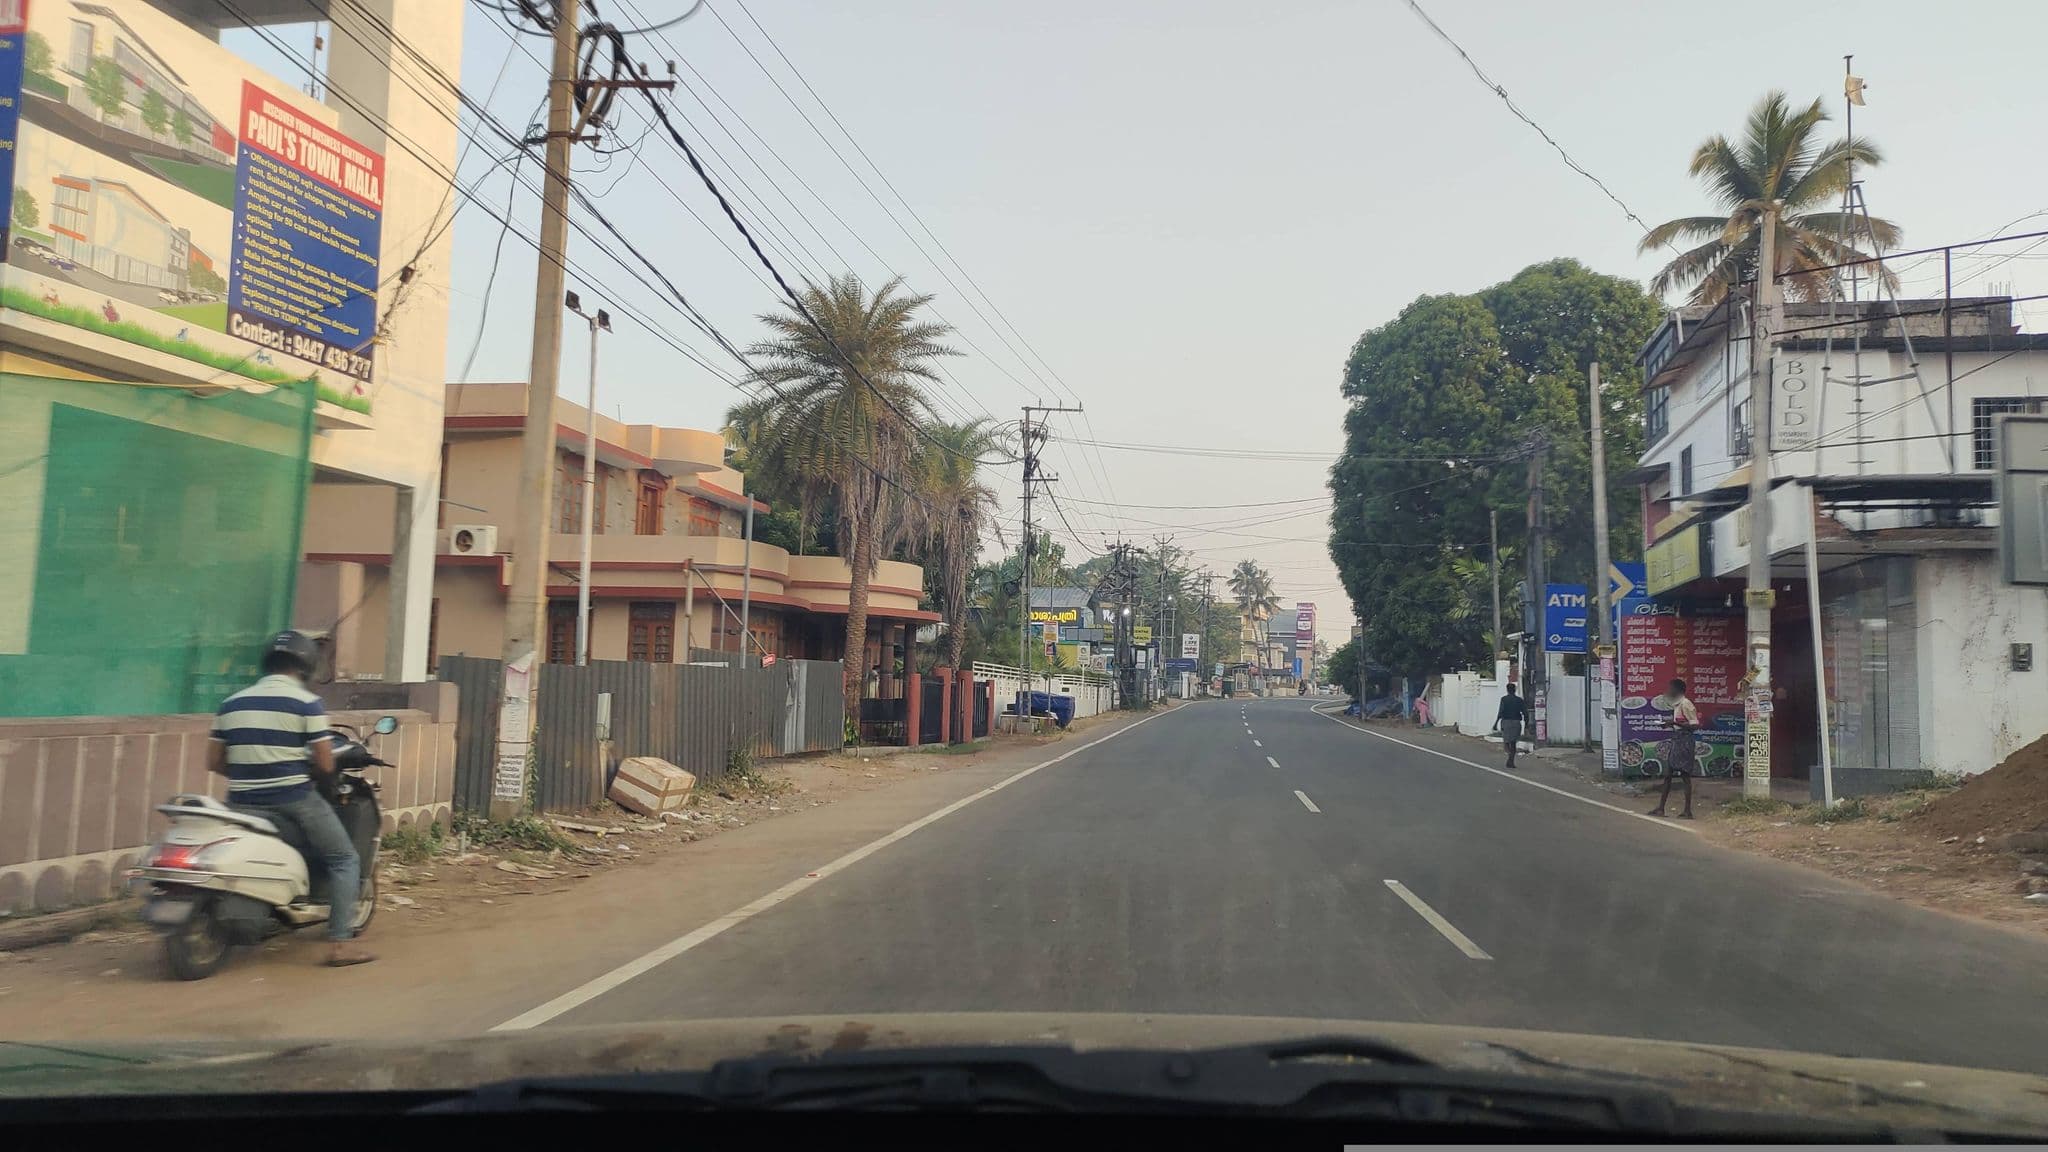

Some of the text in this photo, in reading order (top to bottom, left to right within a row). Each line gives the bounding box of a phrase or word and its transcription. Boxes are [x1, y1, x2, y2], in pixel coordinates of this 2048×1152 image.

[247, 108, 382, 206] PAUL'S TOWN, MALA.
[250, 151, 277, 173] Offering
[313, 182, 348, 208] commercial
[349, 200, 366, 216] space
[367, 209, 376, 221] for
[266, 171, 292, 192] Suitable
[294, 185, 303, 198] for
[246, 212, 273, 231] options.
[247, 187, 270, 206] Ample
[270, 198, 281, 211] car
[282, 203, 307, 223] parking
[330, 225, 359, 247] Basement
[247, 200, 273, 220] parking
[274, 212, 283, 224] for
[293, 221, 307, 235] cars
[308, 227, 320, 241] and
[340, 242, 355, 256] open
[355, 249, 377, 266] parking
[245, 224, 260, 238] Two
[260, 230, 278, 246] large
[244, 236, 281, 259] Advantage
[281, 251, 289, 263] of
[289, 255, 305, 270] easy
[261, 255, 288, 275] junction
[289, 267, 296, 278] to
[242, 272, 252, 285] All
[253, 276, 275, 294] rooms
[288, 290, 303, 304] road
[268, 270, 284, 284] from
[285, 277, 316, 297] maximum
[269, 294, 287, 310] many
[292, 332, 324, 364] 9447
[324, 344, 348, 372] 436
[1781, 360, 1806, 427] BOLD
[1548, 593, 1586, 607] ATM
